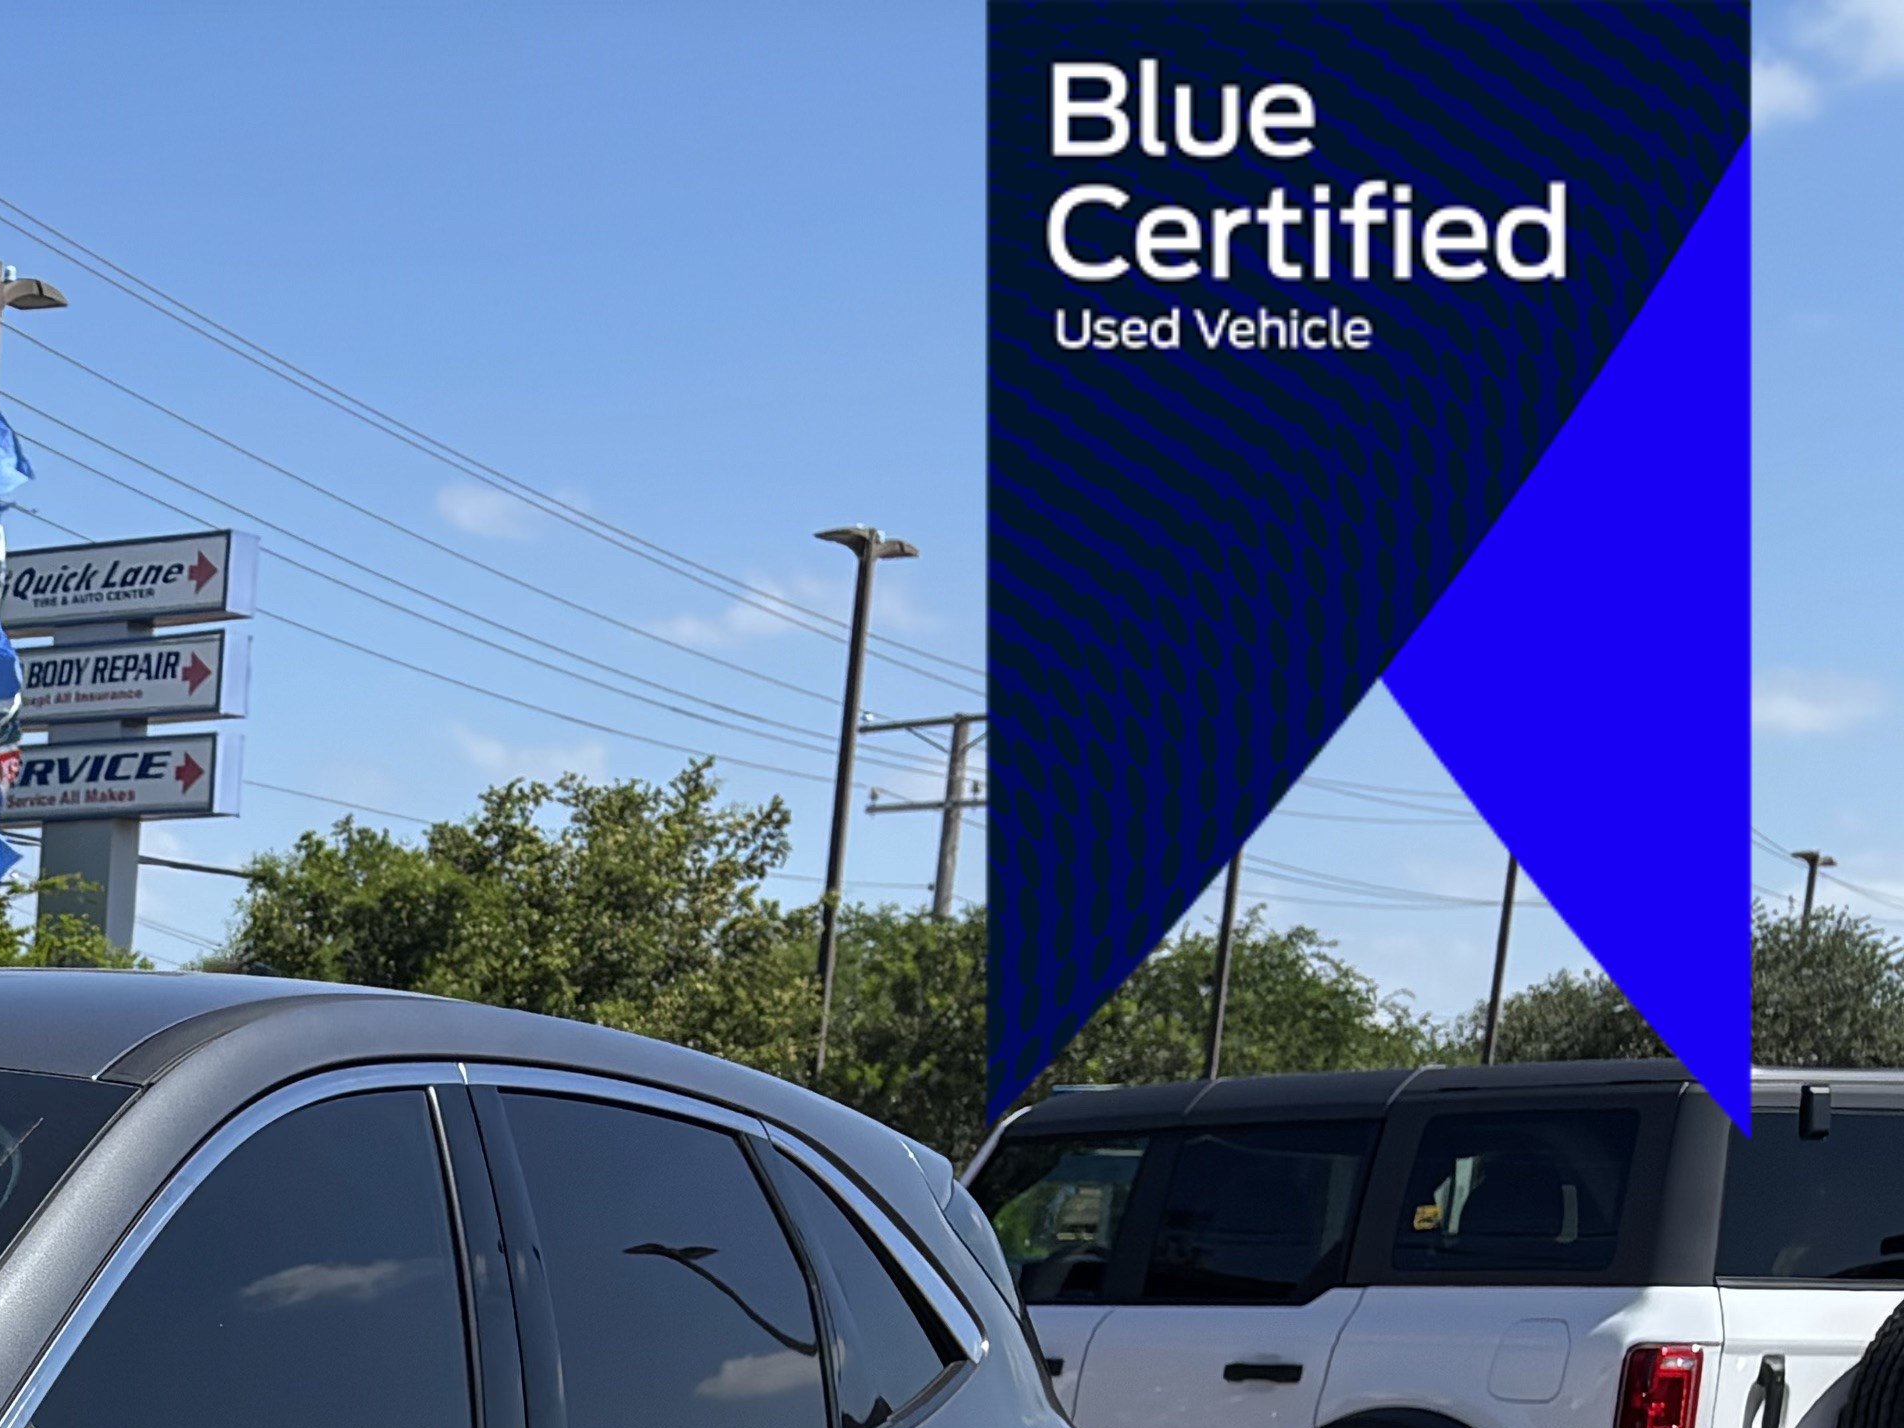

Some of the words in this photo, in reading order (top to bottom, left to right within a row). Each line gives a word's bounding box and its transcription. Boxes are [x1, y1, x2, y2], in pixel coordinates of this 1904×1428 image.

[13, 563, 99, 600] Quick
[100, 560, 184, 589] Lane
[33, 597, 58, 608] TIRE
[61, 596, 69, 606] &
[72, 591, 104, 605] AUTO
[106, 588, 155, 603] CENTER
[26, 657, 90, 689] BODY
[91, 651, 180, 684] REPAIR
[55, 691, 72, 704] All
[74, 689, 144, 702] Insurance
[7, 793, 56, 808] Service
[60, 790, 81, 805] All
[85, 788, 136, 804] Makes
